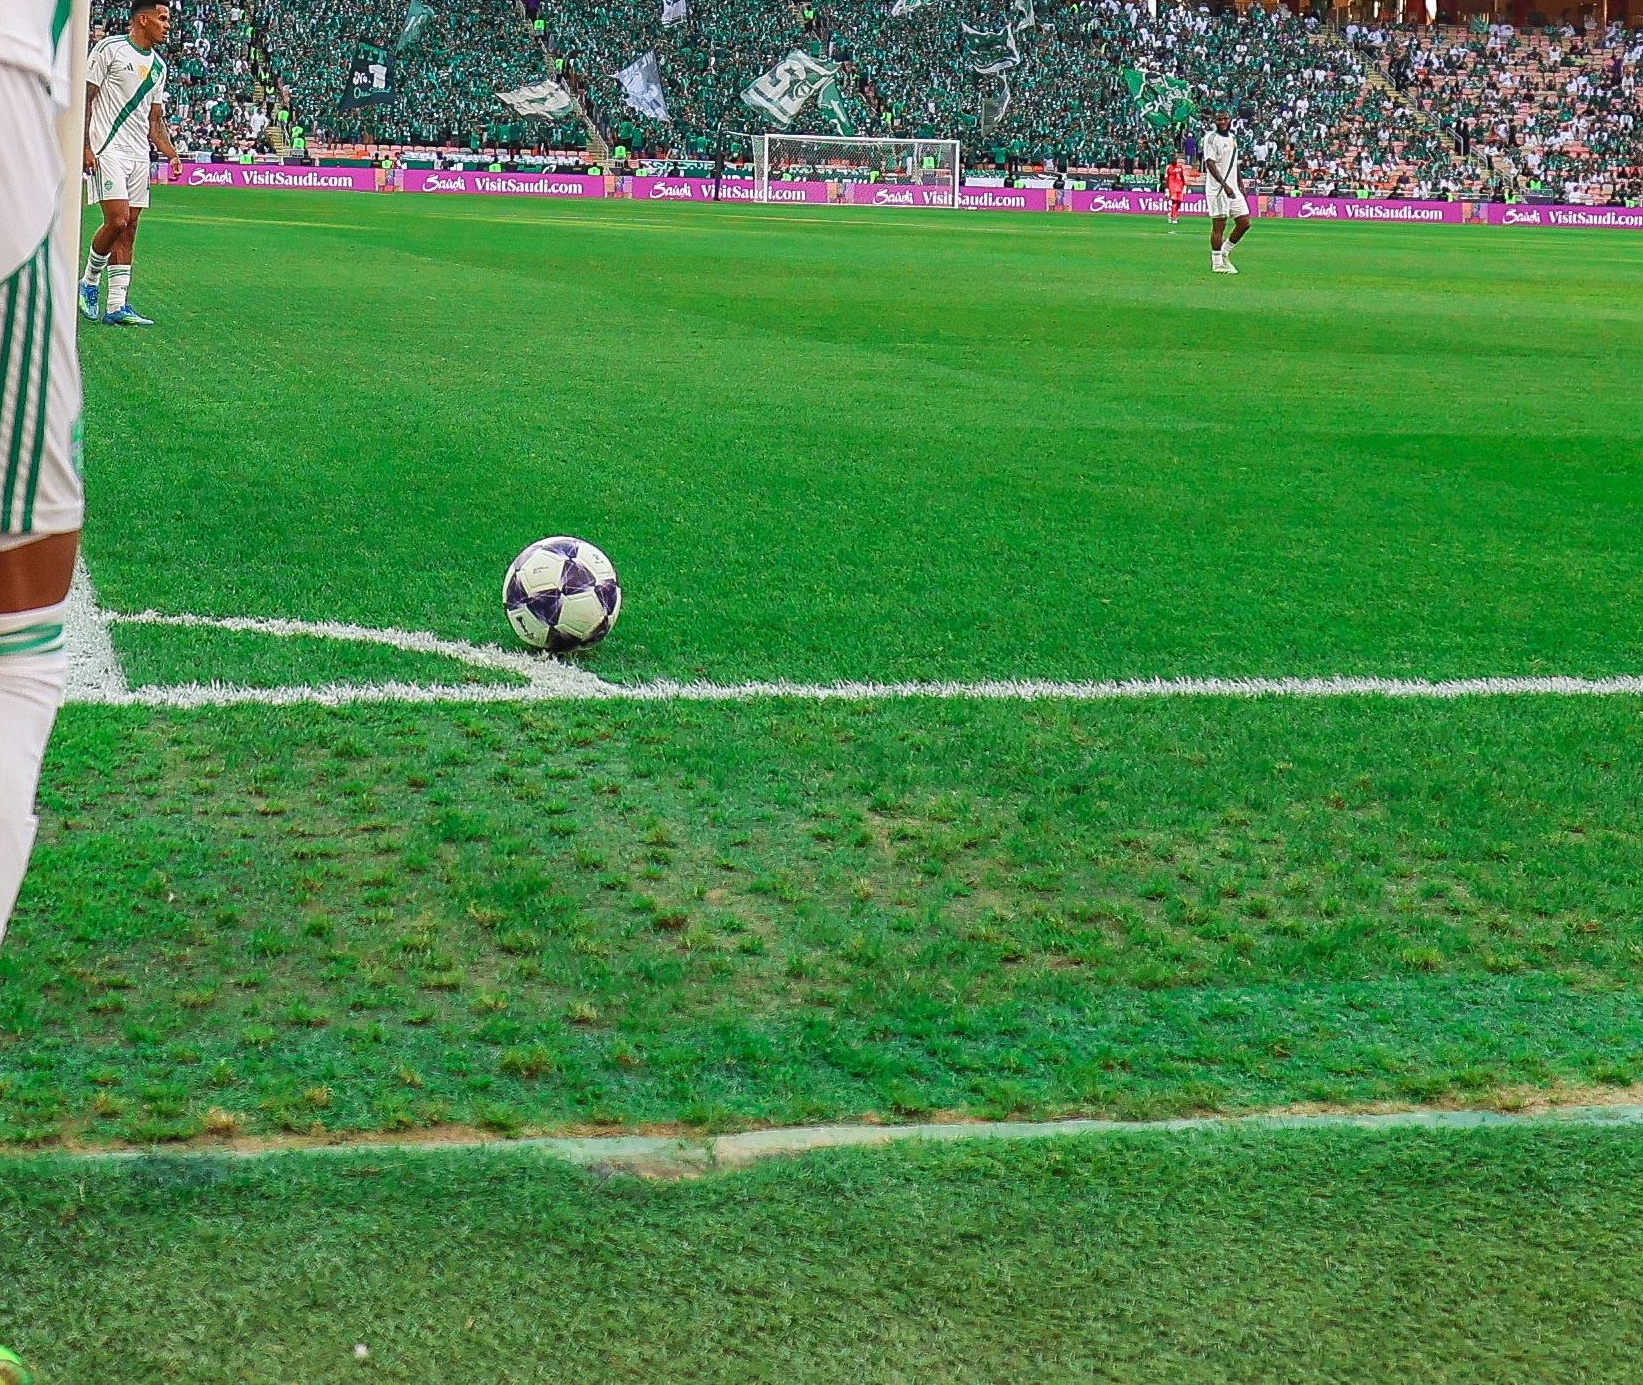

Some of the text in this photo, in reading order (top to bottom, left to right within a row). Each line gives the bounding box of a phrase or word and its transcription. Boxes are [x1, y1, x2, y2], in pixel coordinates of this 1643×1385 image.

[188, 167, 353, 187] Saudi VisitSaudi.com
[422, 174, 583, 194] Saudi VisitSaudi.com
[650, 181, 692, 199] Saudi
[873, 188, 914, 205] Saudi
[1090, 195, 1130, 212] Saudi
[1298, 201, 1443, 220] Saudi VisitSaudi.com
[1502, 208, 1541, 224] Saudi
